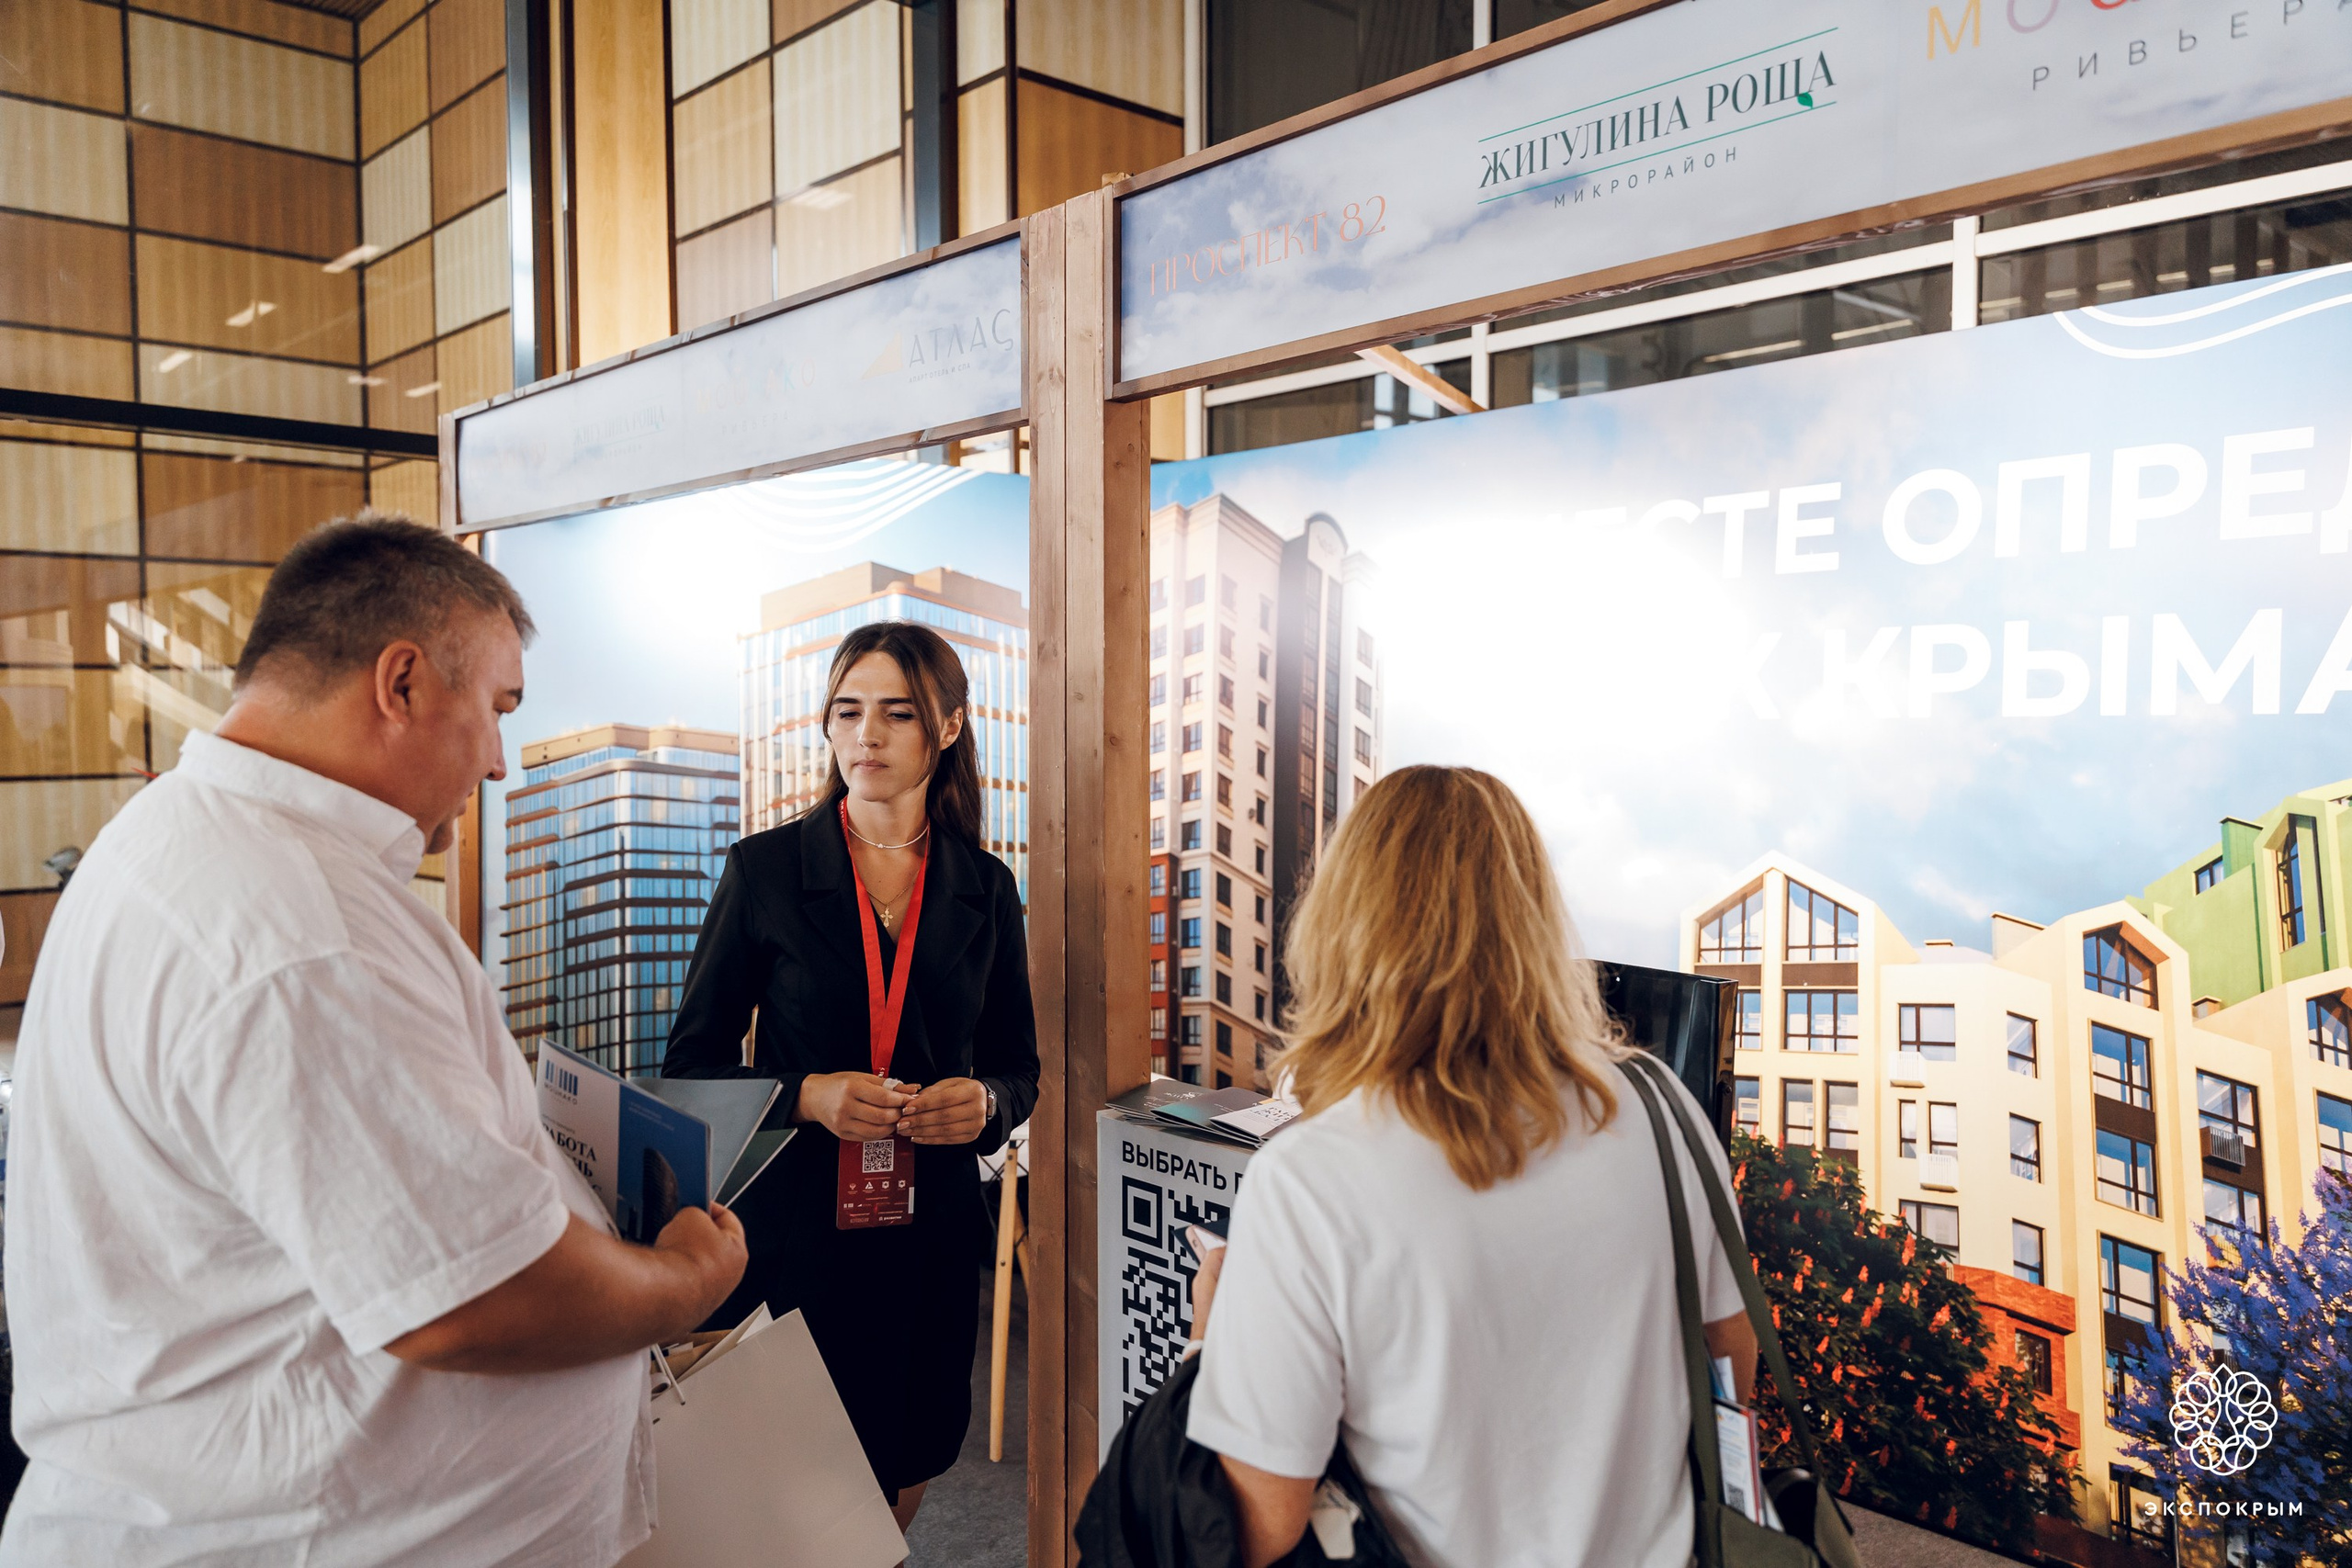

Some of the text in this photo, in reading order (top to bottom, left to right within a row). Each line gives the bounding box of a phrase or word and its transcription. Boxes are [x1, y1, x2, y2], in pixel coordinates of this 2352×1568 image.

[2032, 0, 2352, 90] РИВЬЕР
[1477, 50, 1838, 189] ЖИГУЛИНА РОЩА
[1554, 145, 1738, 210] МИКРОРАЙОН
[1149, 195, 1388, 297] ПРОСПЕКТ 82
[909, 309, 1014, 368] АТЛАС
[1122, 1140, 1227, 1190] ВЫБРАТЬ
